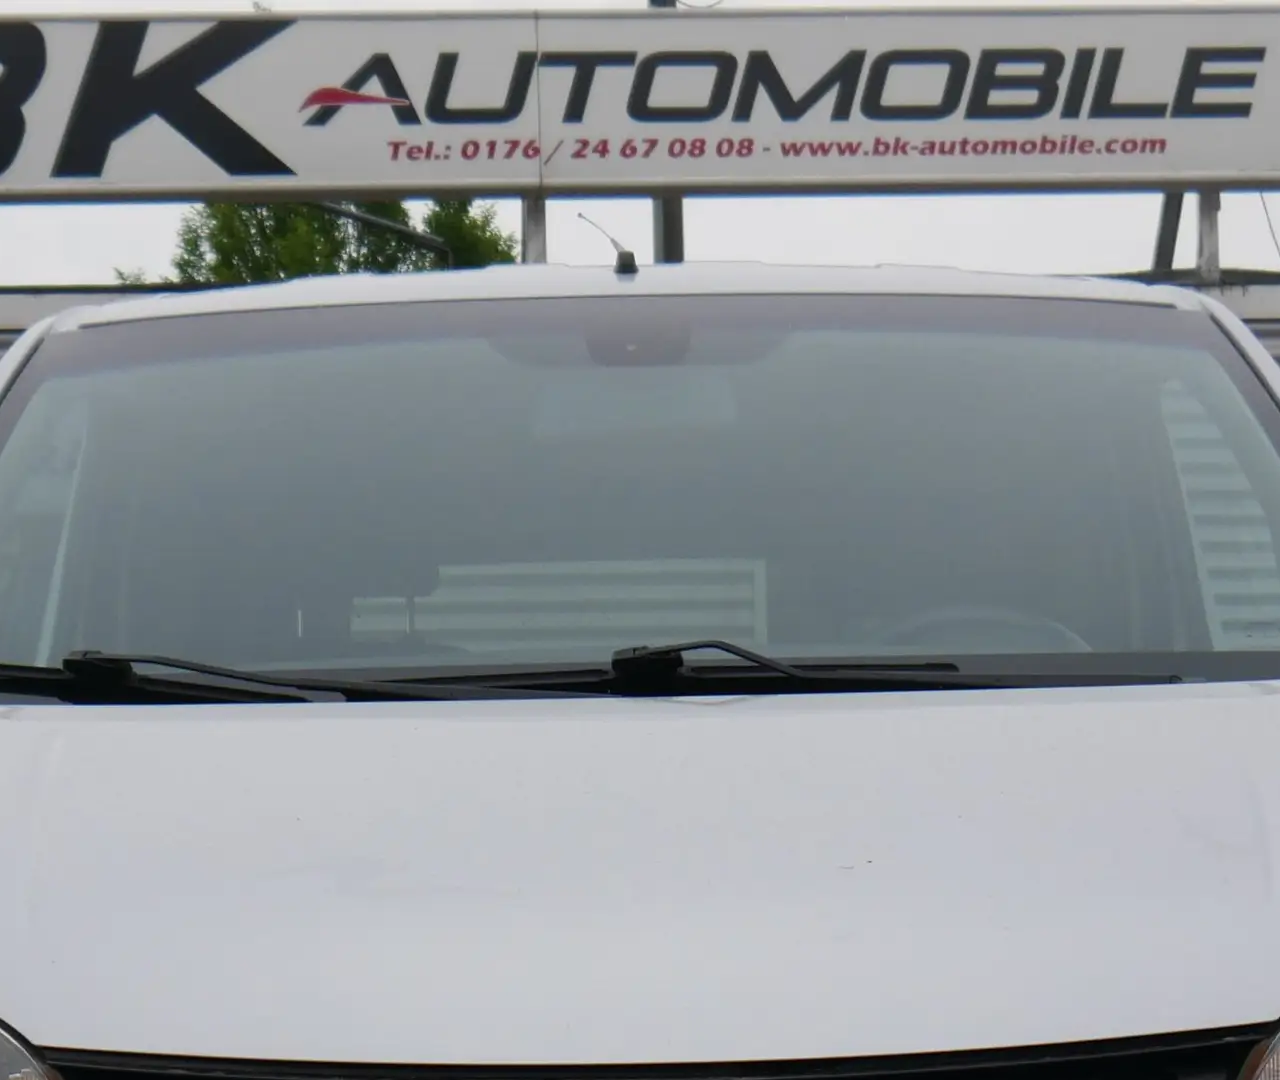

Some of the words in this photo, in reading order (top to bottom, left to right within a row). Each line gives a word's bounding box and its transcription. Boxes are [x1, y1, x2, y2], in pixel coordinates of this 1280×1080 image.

[300, 46, 1266, 127] AUTOMOBILE
[387, 140, 452, 162] Tel.:
[461, 139, 541, 160] 0176
[570, 138, 610, 159] 24
[619, 138, 659, 159] 67
[667, 138, 707, 158] 08
[716, 138, 755, 158] 08
[780, 134, 1168, 158] www.bk-automobile.com
